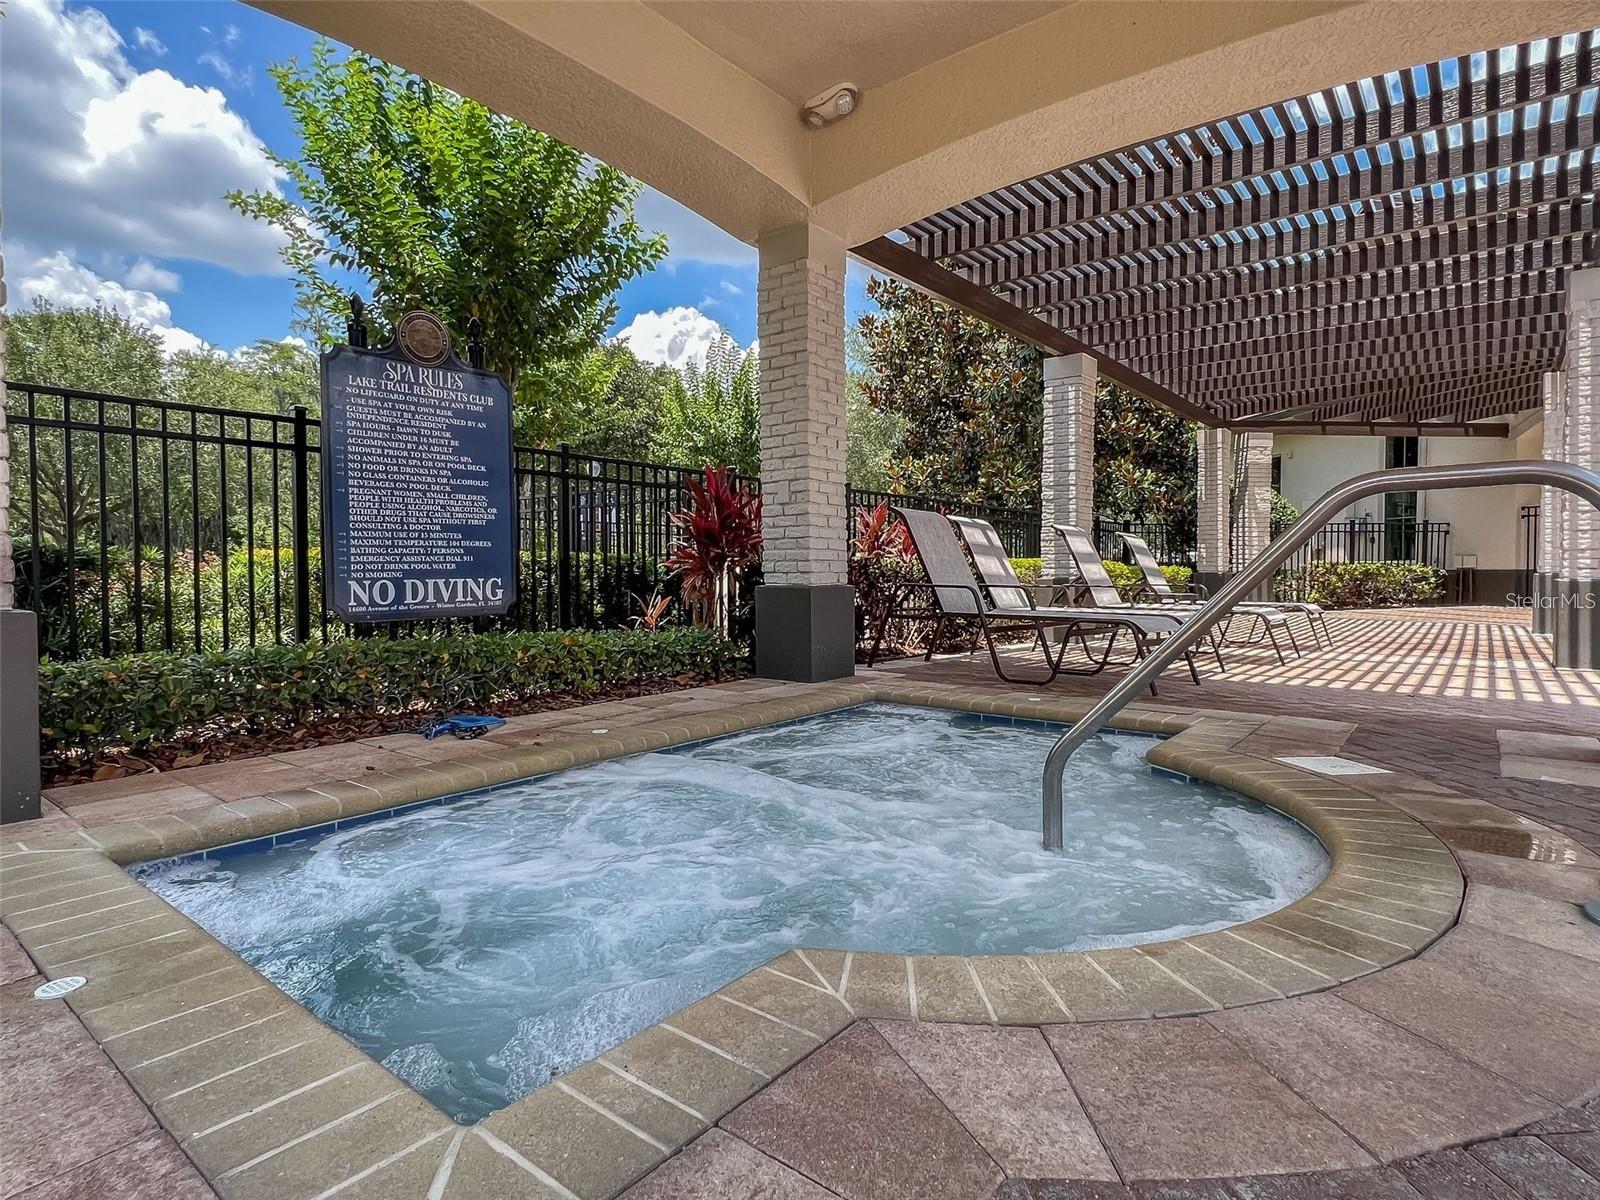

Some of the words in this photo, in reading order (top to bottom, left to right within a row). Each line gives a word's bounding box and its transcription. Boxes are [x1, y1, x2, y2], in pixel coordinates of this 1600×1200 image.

[383, 361, 415, 382] SPA
[419, 367, 463, 390] RULES
[348, 375, 377, 388] LAKE
[380, 380, 411, 393] TRAIL
[413, 385, 467, 401] RESIDENTS
[470, 394, 493, 405] CLUB
[361, 389, 405, 401] LIFEGUARD
[351, 397, 366, 405] USE
[395, 403, 416, 411] YOUR
[417, 406, 434, 414] OWN
[436, 409, 453, 417] RISK
[346, 405, 378, 414] GUESTS
[380, 409, 401, 417] MUST
[414, 414, 466, 426] ACCOMPANIED
[346, 412, 410, 425] INDEPENDENCE
[411, 420, 447, 430] RESIDENT
[363, 422, 391, 431] HOURS
[397, 426, 418, 434] DAWN
[347, 429, 389, 439] CHILDREN
[391, 434, 418, 442] UNDER
[428, 437, 449, 446] MUST
[347, 437, 406, 449] ACCOMPANIED
[430, 446, 453, 454] ADULT
[348, 446, 382, 454] SHOWER
[384, 449, 408, 457] PRIOR
[422, 453, 459, 462] ENTERING
[362, 455, 396, 464] ANIMALS
[467, 464, 486, 472] DECK
[362, 463, 385, 471] FOOD
[400, 466, 429, 475] DRINKS
[348, 479, 395, 488] BEVERAGES
[431, 484, 451, 492] DECK
[388, 474, 436, 483] CONTAINERS
[449, 479, 489, 487] ALCOHOLIC
[349, 487, 392, 496] PREGNANT
[426, 492, 450, 500] SMALL
[349, 494, 380, 502] PEOPLE
[404, 497, 434, 505] HEALTH
[435, 498, 473, 507] PROBLEMS
[349, 501, 380, 509] PEOPLE
[381, 502, 406, 510] USING
[350, 514, 383, 522] SHOULD
[452, 512, 495, 520] DROWSINESS
[350, 522, 402, 530] CONSULTING
[409, 523, 441, 531] DOCTOR
[350, 530, 391, 538] MAXIMUM
[347, 579, 396, 606] NO
[403, 577, 504, 604] DIVING
